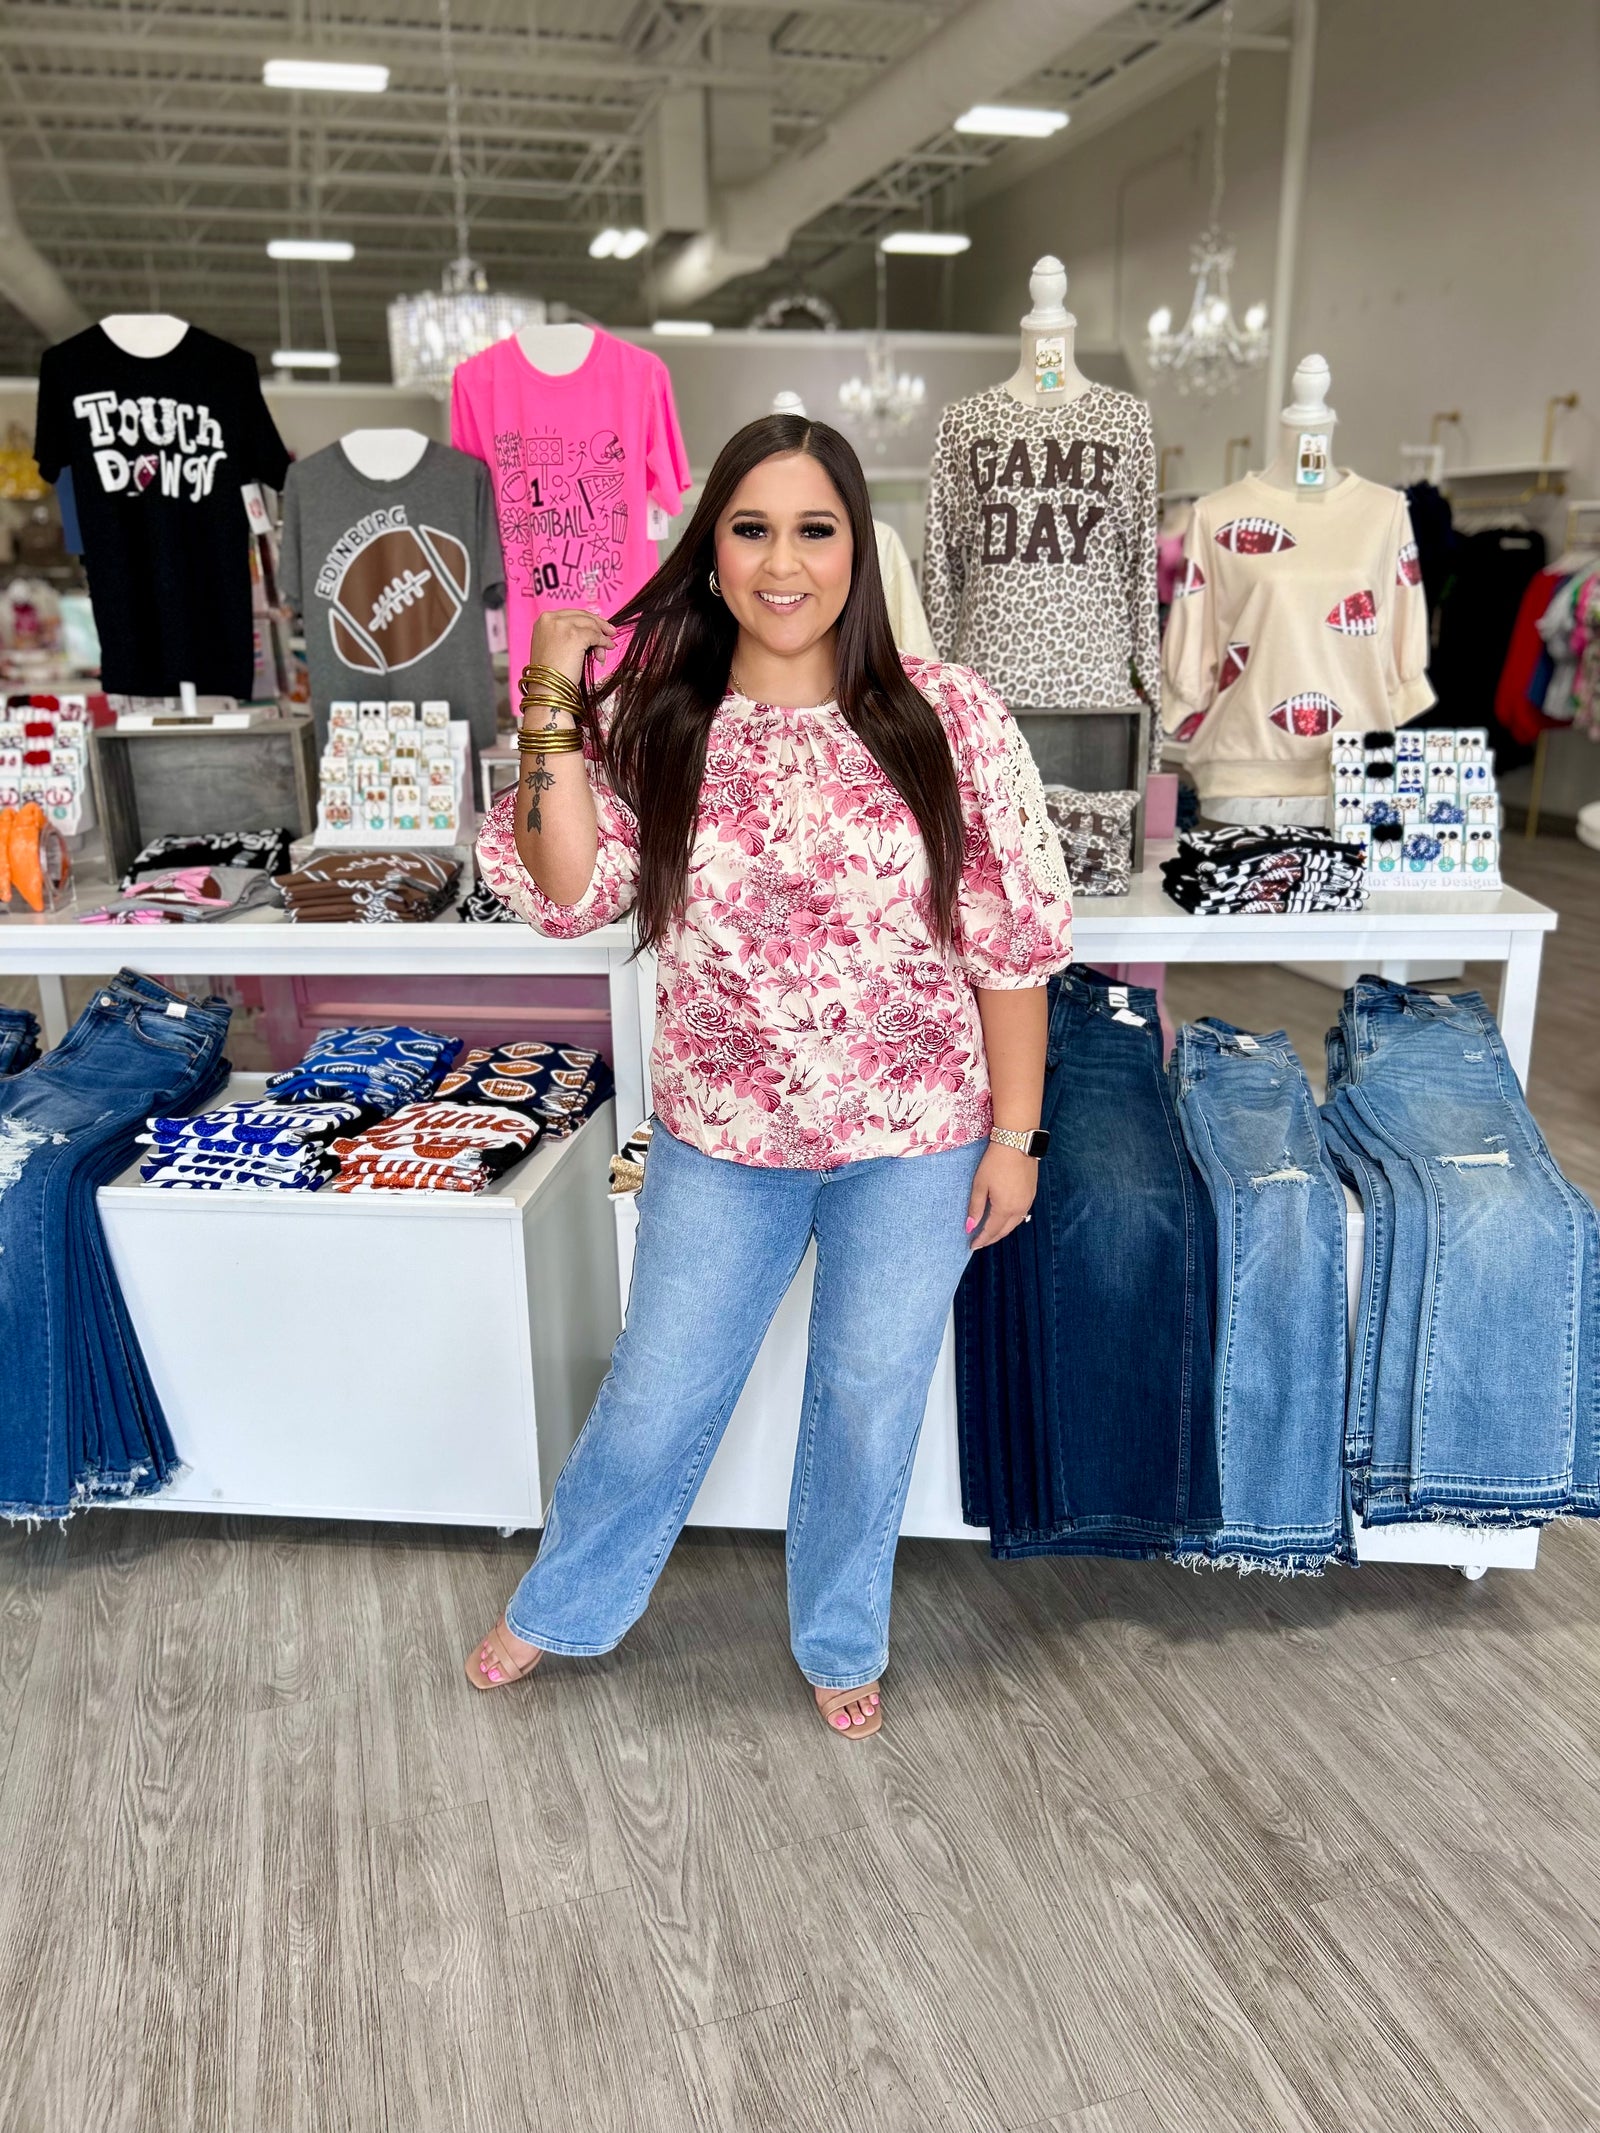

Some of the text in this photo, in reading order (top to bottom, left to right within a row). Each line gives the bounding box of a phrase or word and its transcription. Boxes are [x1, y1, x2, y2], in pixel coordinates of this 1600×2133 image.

[584, 476, 617, 498] TEAM
[970, 439, 1120, 498] GAME
[314, 505, 408, 600] EDINBURG
[981, 503, 1105, 565] DAY
[1397, 874, 1438, 891] Shaye
[1442, 874, 1499, 891] Designs
